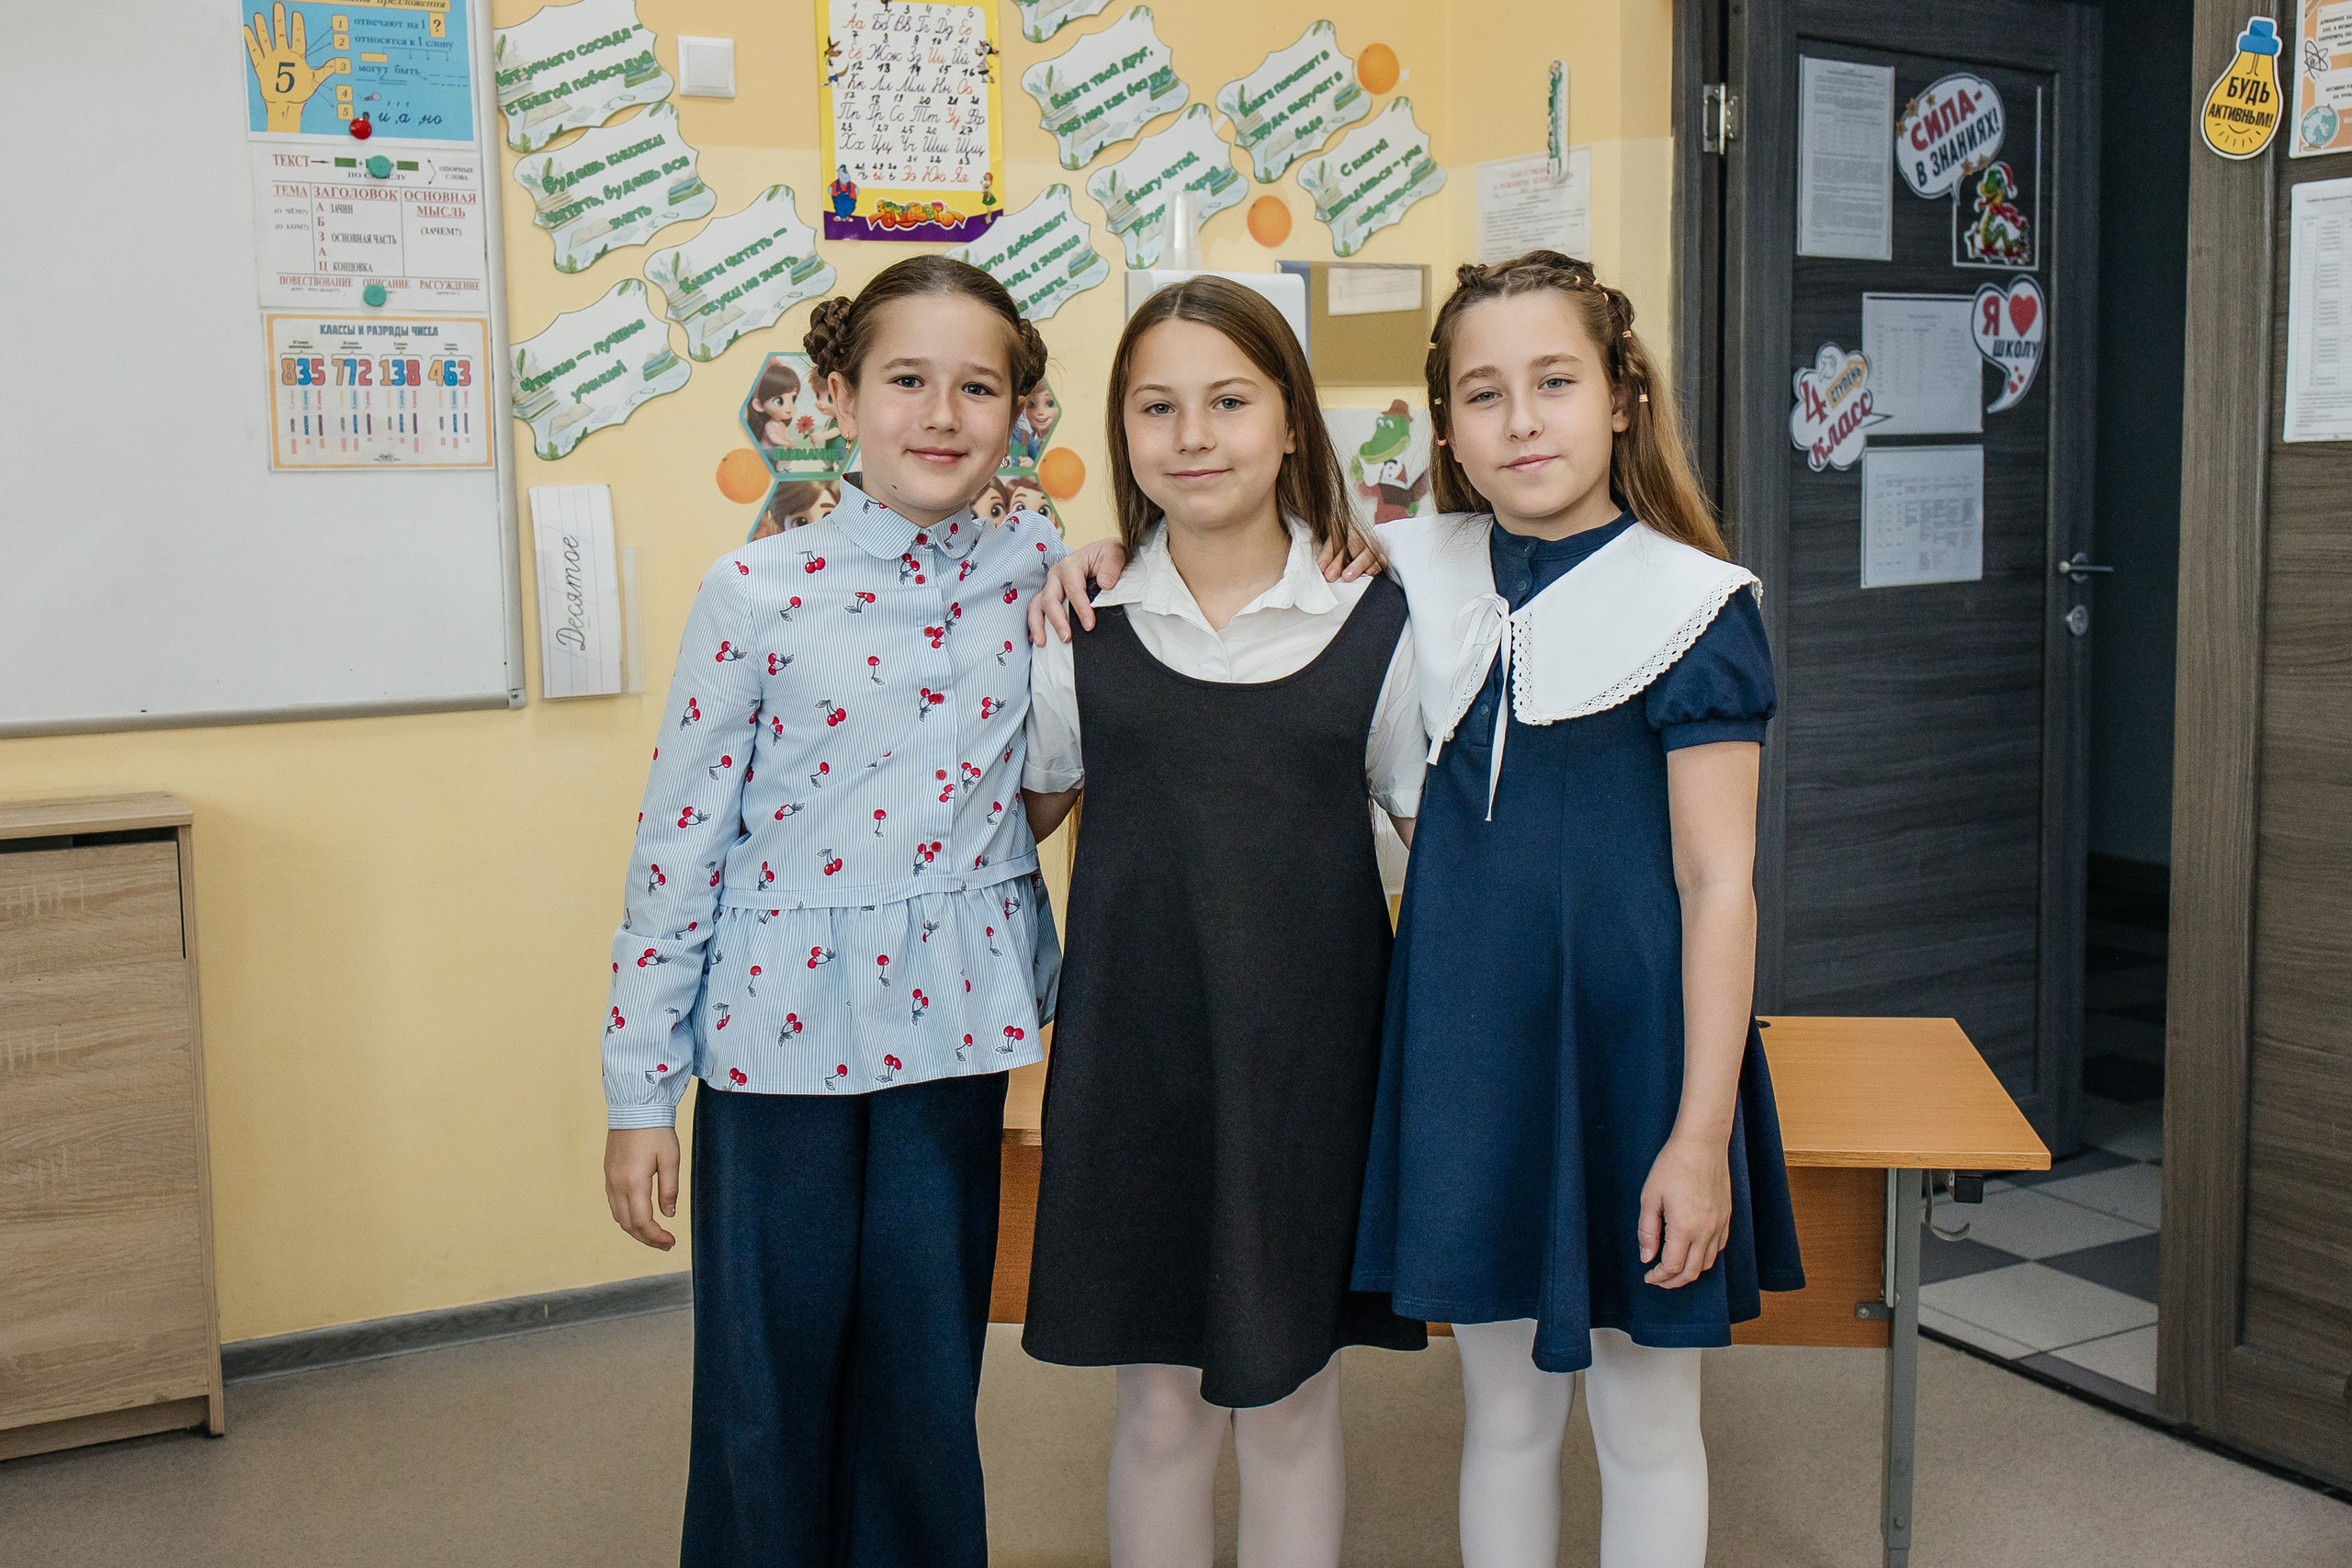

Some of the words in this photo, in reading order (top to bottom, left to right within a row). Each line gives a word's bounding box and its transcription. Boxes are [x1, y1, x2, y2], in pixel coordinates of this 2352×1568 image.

[354, 18, 403, 28] отвечают
[407, 21, 419, 29] на
[433, 19, 442, 32] ?
[967, 6, 974, 18] 6
[339, 38, 345, 47] 2
[355, 36, 407, 46] относятся
[425, 40, 455, 51] слову
[522, 50, 576, 81] умного
[576, 28, 633, 57] соседа
[275, 62, 296, 94] 5
[340, 62, 346, 72] 3
[358, 65, 388, 75] могут
[517, 82, 573, 112] книгой
[571, 50, 655, 92] побеседуй
[342, 88, 348, 98] 4
[2227, 76, 2271, 107] БУДЬ
[343, 107, 349, 117] 5
[2207, 103, 2275, 129] АКТИВНЫМ!
[272, 153, 311, 168] ТЕКСТ
[1351, 138, 1390, 171] книгой
[1916, 160, 1928, 188] В
[1932, 107, 2001, 179] ЗНАНИЯХ!
[541, 161, 606, 197] Будешь
[605, 134, 666, 166] книжки
[274, 185, 308, 197] ТЕМА
[313, 186, 398, 200] ЗАГОЛОВОК
[404, 190, 476, 203] ОСНОВНАЯ
[545, 196, 605, 224] читать,
[603, 169, 662, 200] будешь
[331, 203, 353, 215] ЗАЧИН
[416, 205, 466, 218] МЫСЛЬ
[608, 206, 653, 230] знать
[332, 232, 372, 244] ОСНОВНАЯ
[373, 234, 398, 245] ЧАСТЬ
[1006, 210, 1068, 260] добывают
[1038, 234, 1081, 268] знания
[333, 261, 374, 273] КОНЦОВКА
[679, 263, 727, 294] Книги
[724, 237, 774, 268] читать
[278, 276, 354, 288] ПОВЕСТВОВАНИЕ
[420, 280, 481, 291] РАССУЖДЕНИЕ
[699, 286, 744, 317] скуки
[741, 276, 761, 293] не
[758, 256, 799, 283] знать
[1982, 295, 2000, 336] Я
[320, 324, 356, 335] КЛАССЫ
[358, 325, 364, 335] И
[367, 325, 409, 337] РАЗРЯДЫ
[412, 326, 439, 336] ЧИСЕЛ
[520, 358, 577, 393] Чтение
[594, 319, 646, 355] лучшее
[1992, 339, 2041, 359] ШКОЛУ
[281, 357, 325, 386] 835
[332, 358, 372, 386] 772
[379, 359, 421, 386] 138
[428, 359, 471, 387] 463
[1802, 379, 1828, 425] 4
[1812, 391, 1873, 467] класс
[555, 535, 586, 652] Десятое
